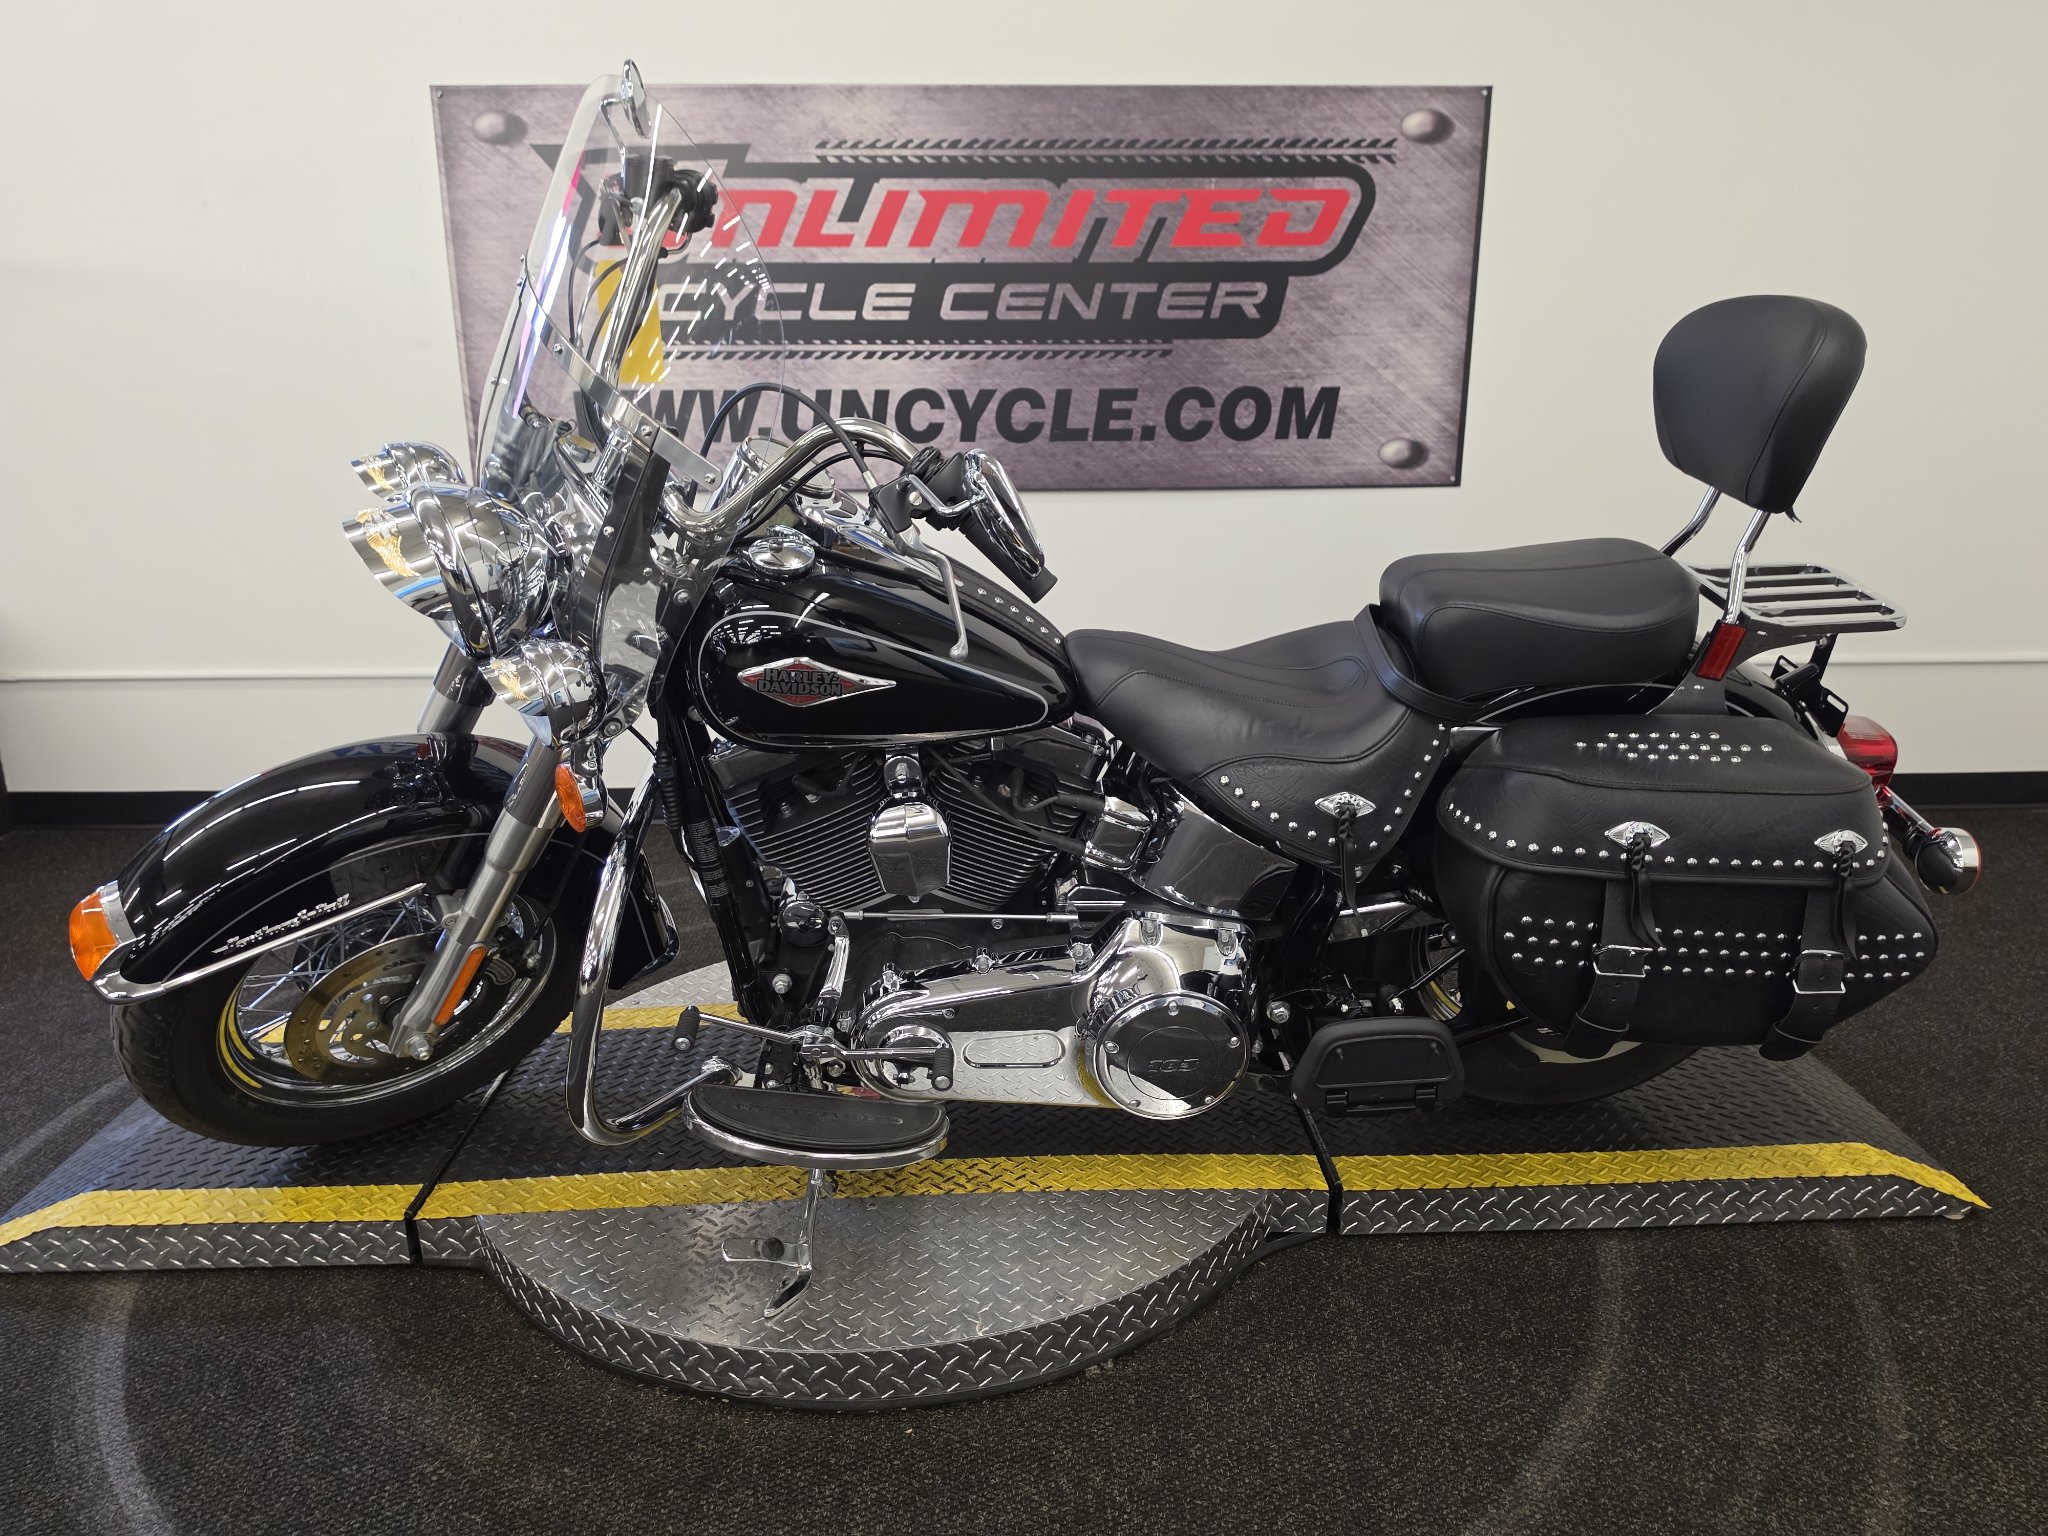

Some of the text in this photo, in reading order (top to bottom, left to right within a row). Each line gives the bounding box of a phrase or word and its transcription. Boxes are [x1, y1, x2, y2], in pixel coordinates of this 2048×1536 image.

[600, 186, 1351, 248] NLIMITED
[657, 281, 1268, 321] CYCLE CENTER
[756, 679, 842, 696] DAVIDSON
